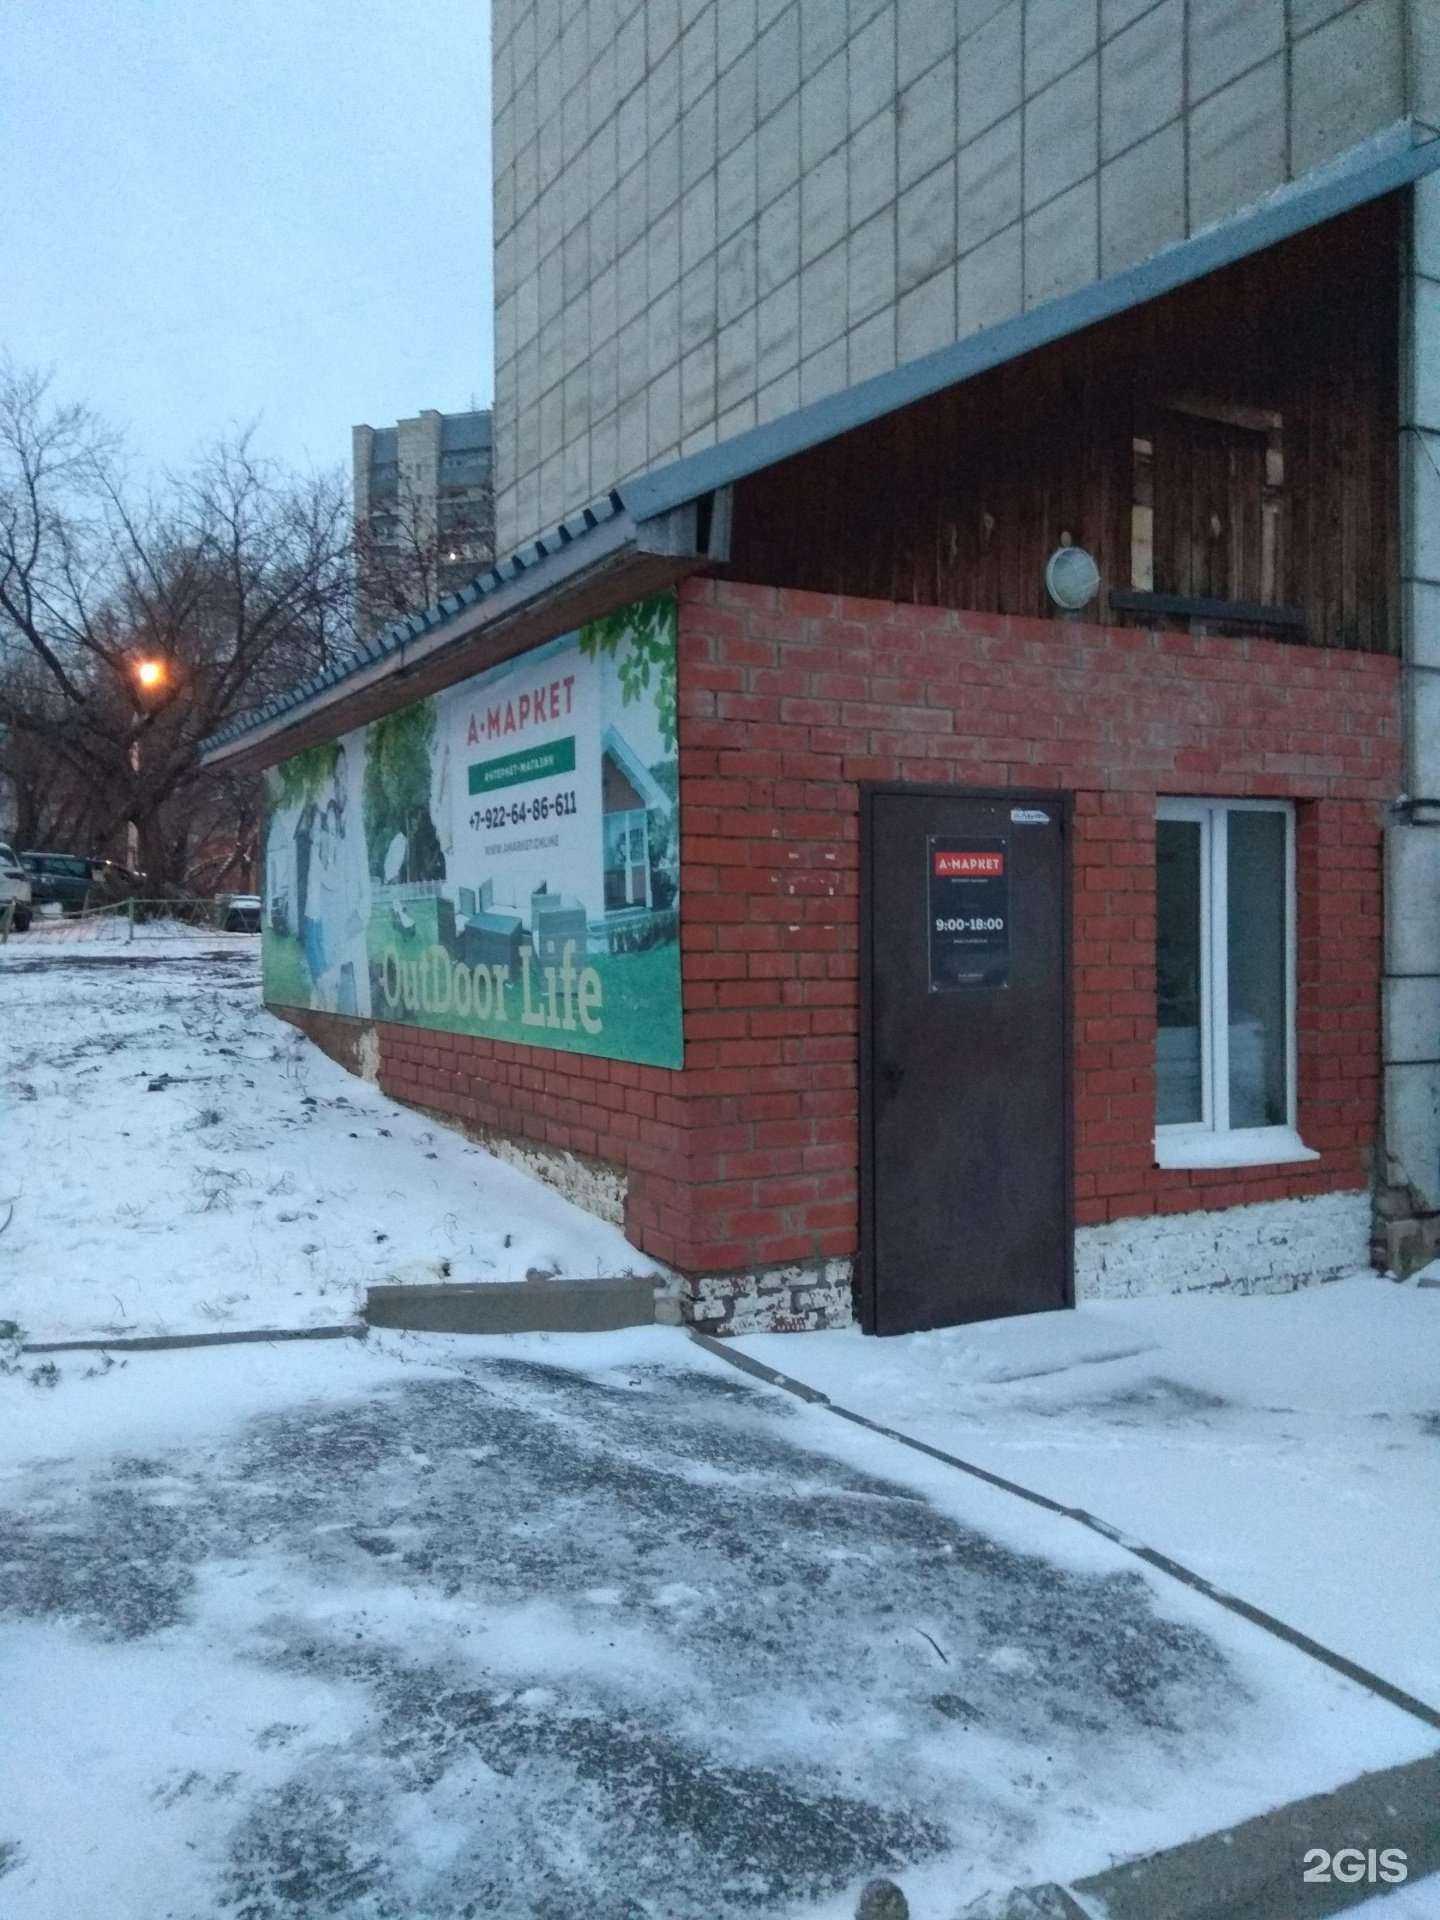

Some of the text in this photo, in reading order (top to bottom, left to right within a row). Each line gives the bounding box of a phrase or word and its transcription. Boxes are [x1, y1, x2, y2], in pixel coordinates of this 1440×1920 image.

[469, 791, 577, 831] +7-922-64-86-611
[936, 918, 1003, 931] 9:00-18:00
[380, 939, 603, 1034] OutDoor Life
